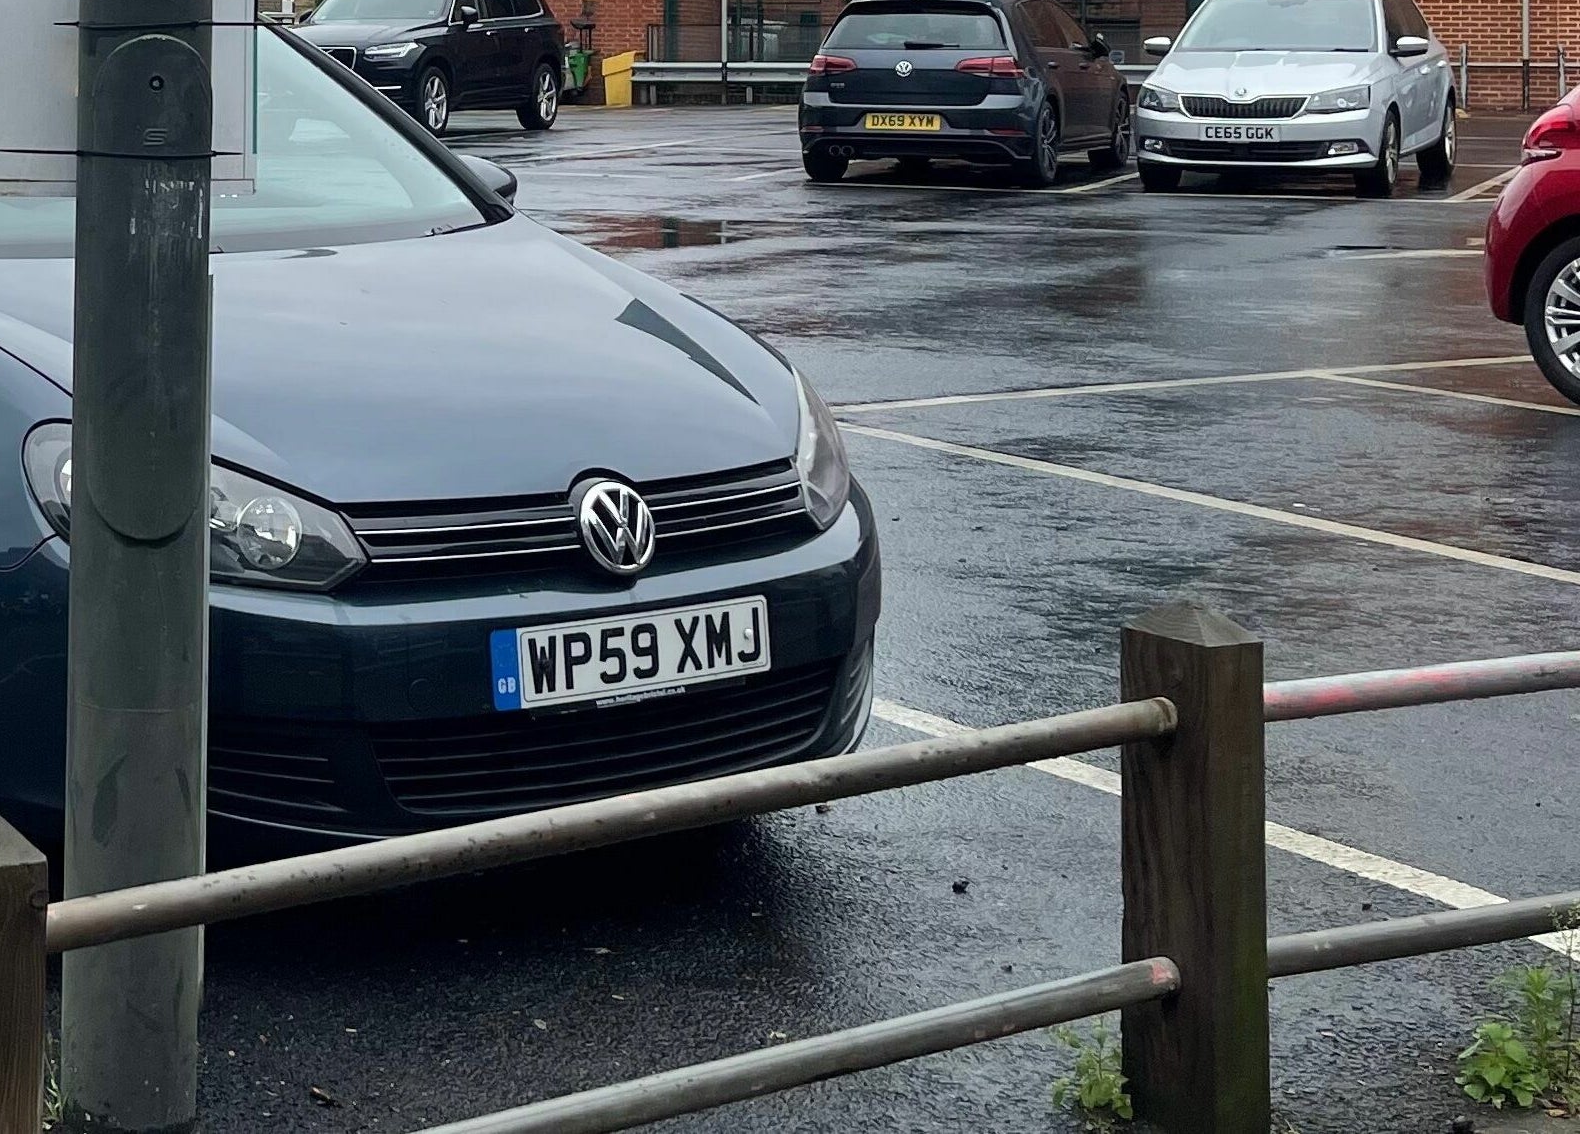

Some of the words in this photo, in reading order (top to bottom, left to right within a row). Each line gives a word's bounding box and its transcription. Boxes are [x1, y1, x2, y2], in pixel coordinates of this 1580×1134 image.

[871, 114, 905, 127] DX69
[908, 115, 934, 128] XYM
[1205, 126, 1242, 139] CE65
[1245, 127, 1274, 140] GGK
[527, 623, 660, 694] WP59
[674, 607, 761, 674] XMJ
[497, 676, 516, 694] GB
